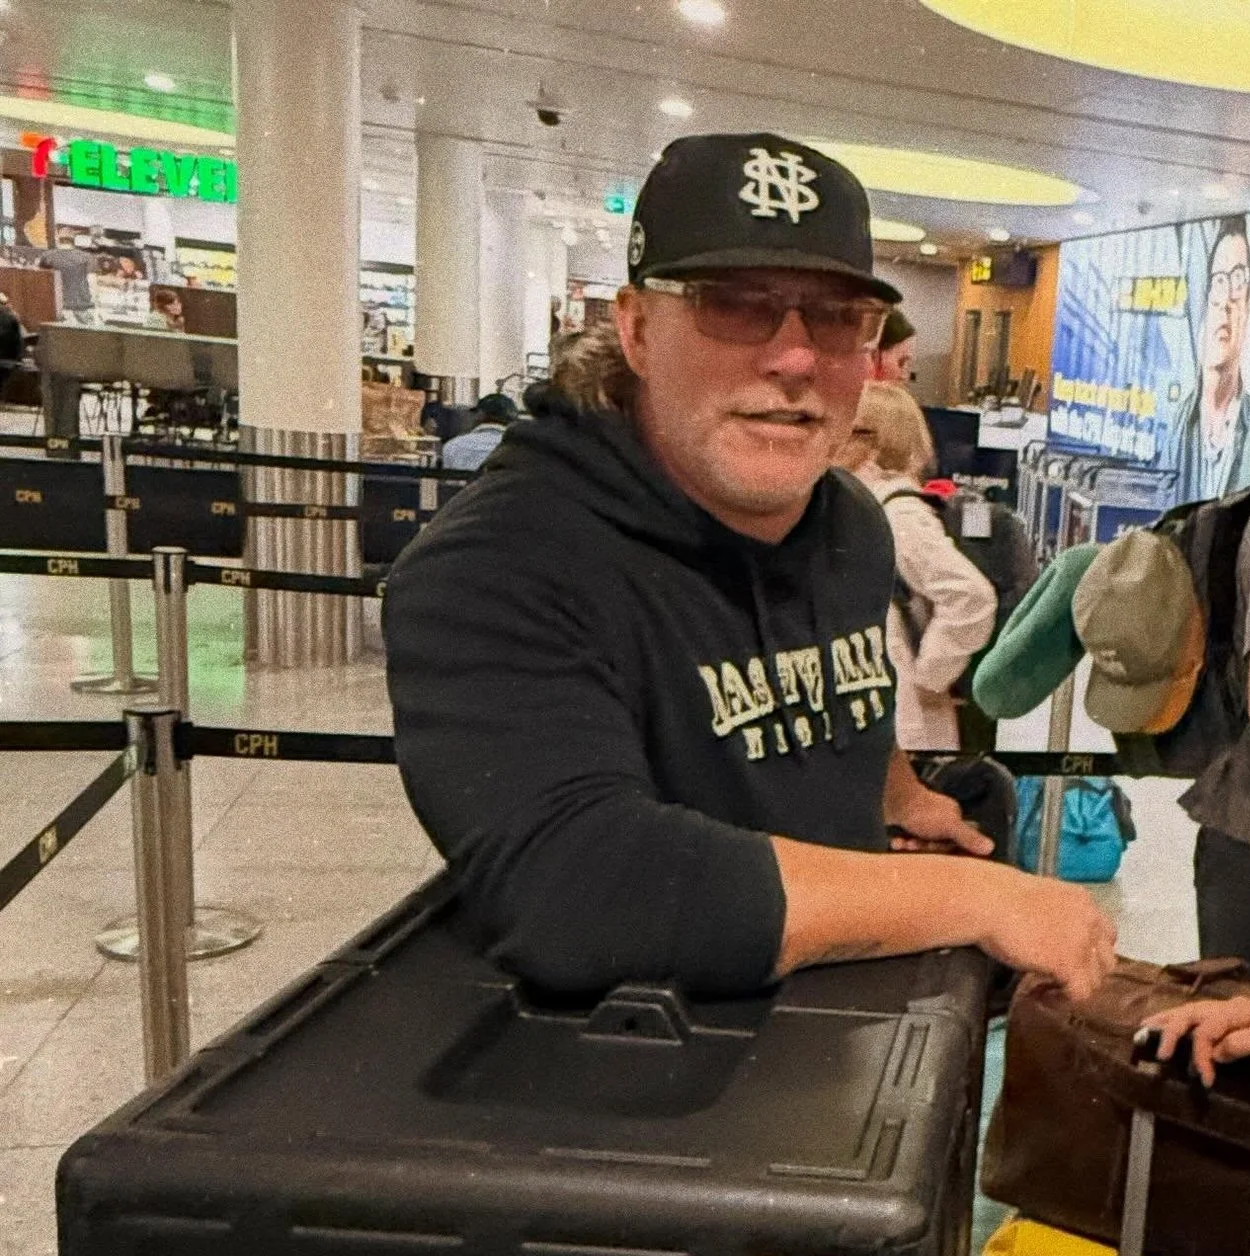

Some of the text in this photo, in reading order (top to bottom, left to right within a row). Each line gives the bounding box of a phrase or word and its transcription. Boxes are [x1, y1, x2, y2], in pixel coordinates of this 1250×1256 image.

[47, 559, 79, 575] CPH
[221, 569, 250, 585] CPH
[234, 733, 279, 756] CPH
[1062, 755, 1094, 775] CPH
